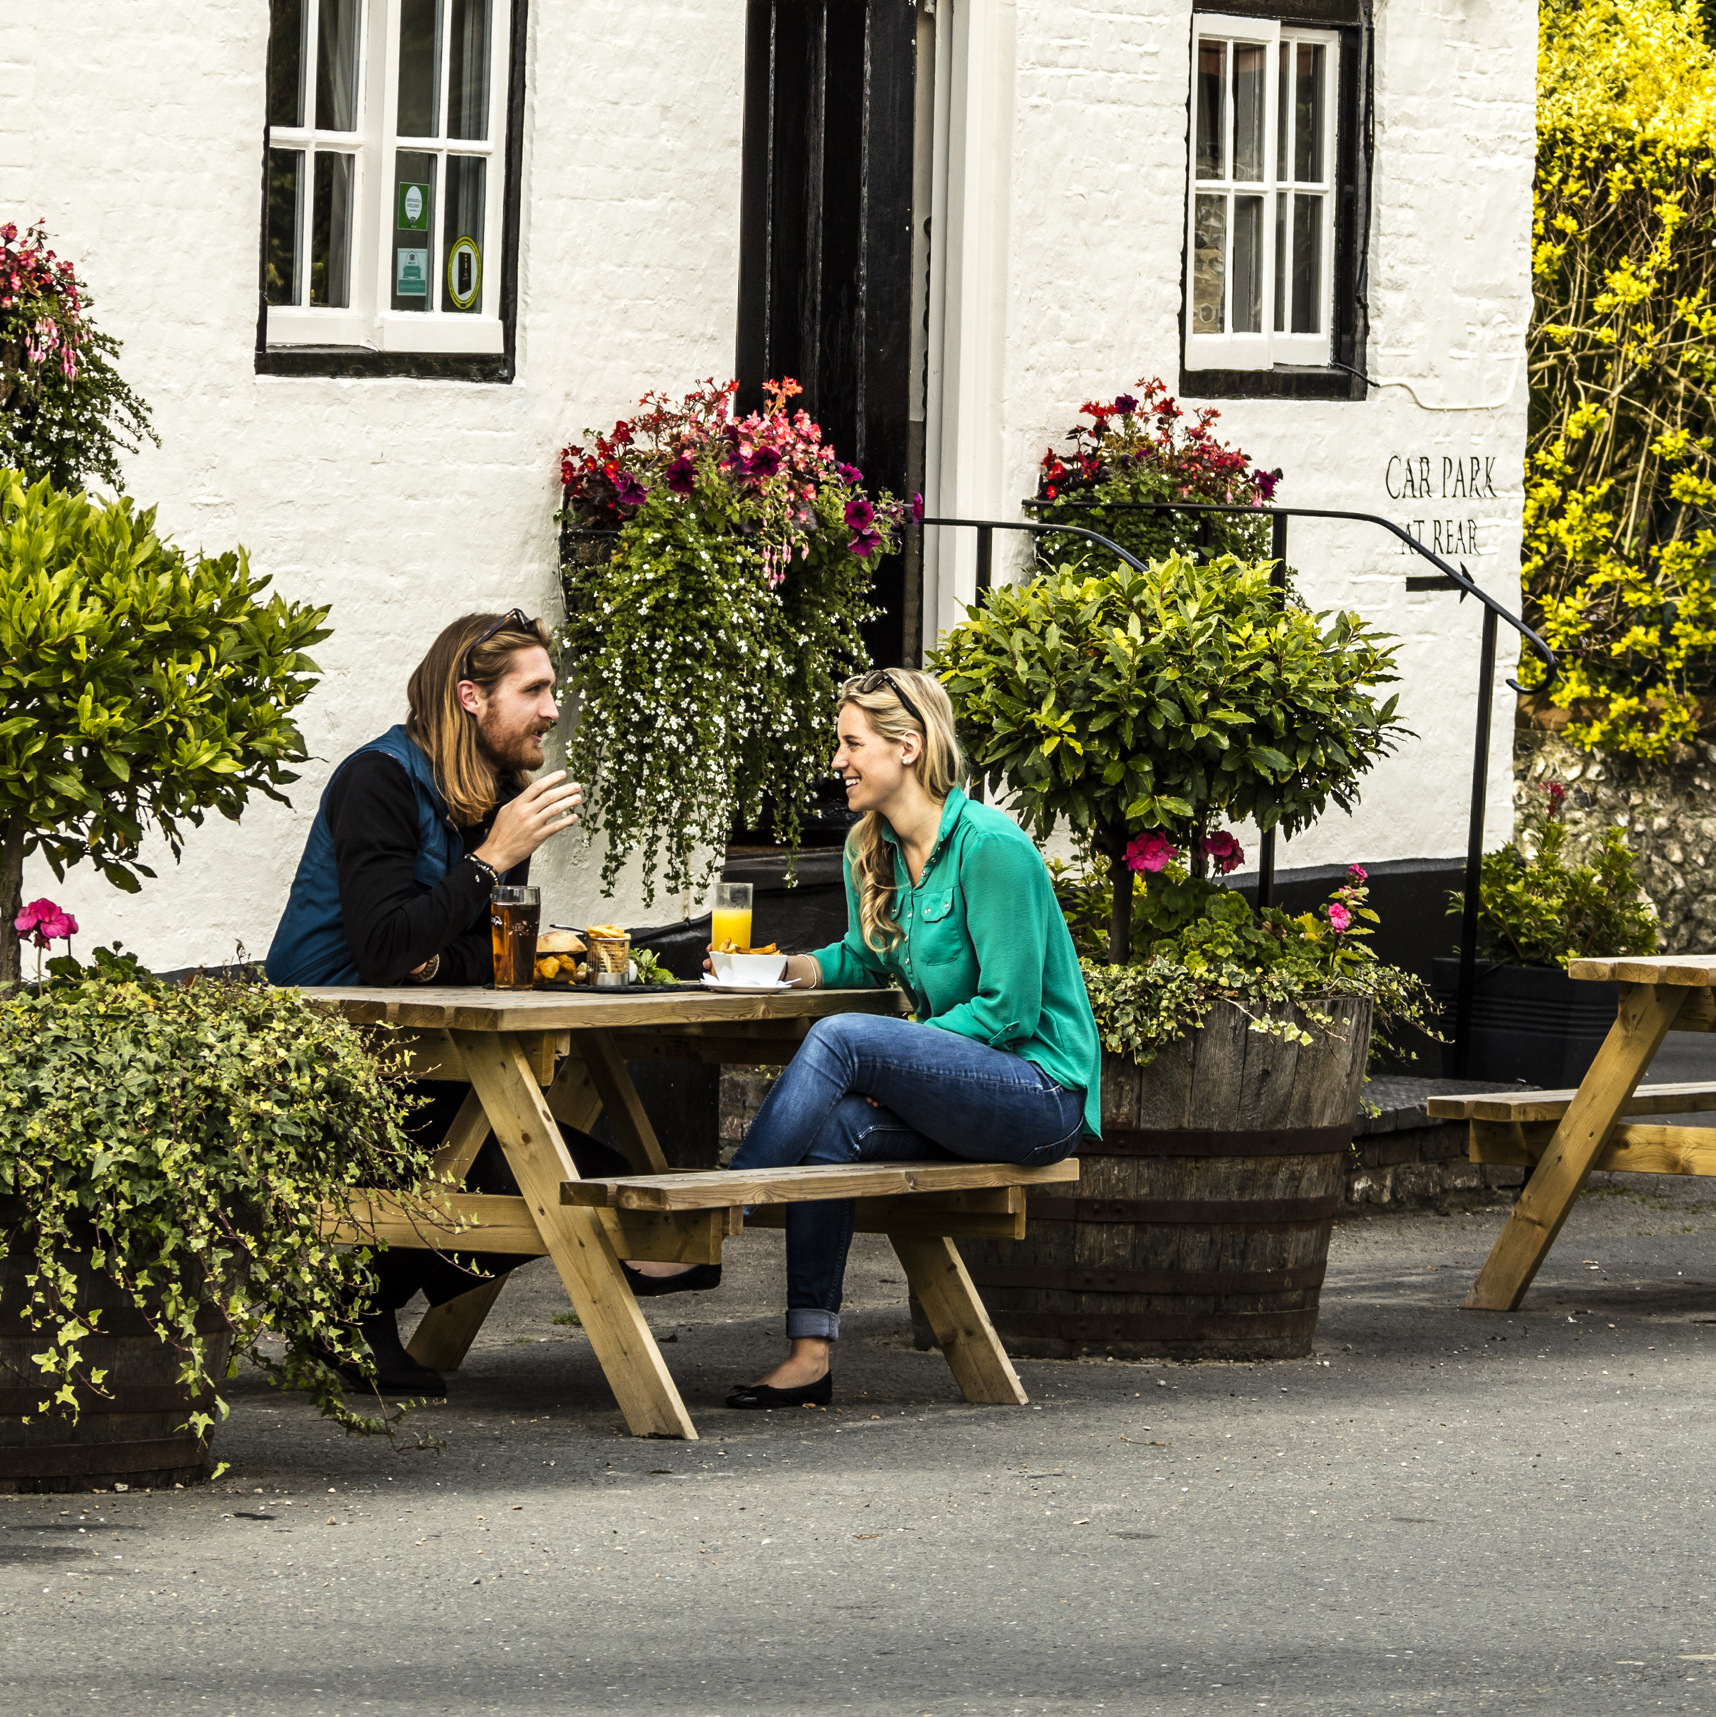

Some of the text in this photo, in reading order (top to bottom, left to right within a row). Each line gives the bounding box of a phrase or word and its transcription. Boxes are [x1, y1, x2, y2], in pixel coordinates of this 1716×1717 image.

[1385, 455, 1498, 500] CAR PARK
[1401, 519, 1481, 555] AT REAR
